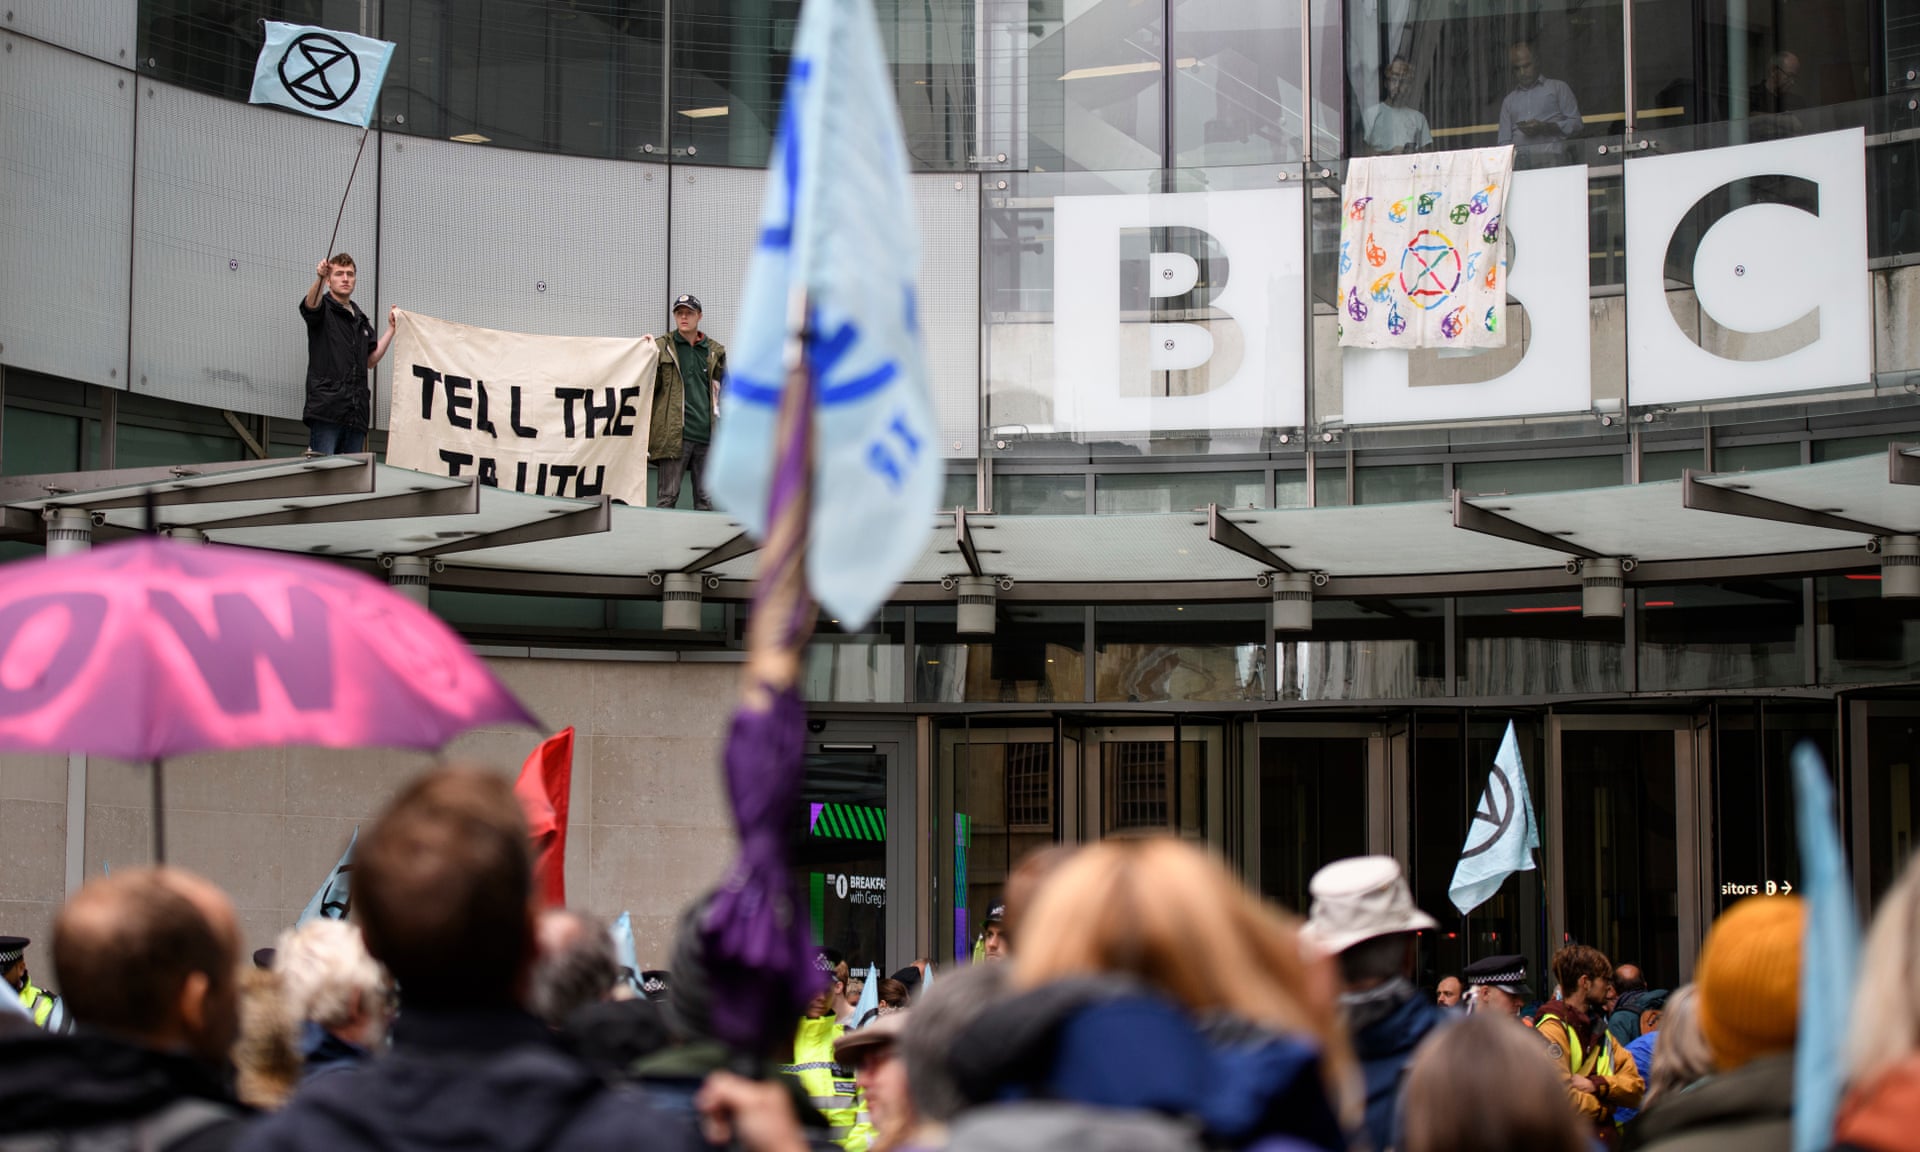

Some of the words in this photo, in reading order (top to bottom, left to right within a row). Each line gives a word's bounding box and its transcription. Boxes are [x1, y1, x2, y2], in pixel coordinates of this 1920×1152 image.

[412, 364, 539, 439] TELL
[554, 385, 641, 439] THE
[850, 890, 864, 904] with
[865, 891, 882, 908] Greg
